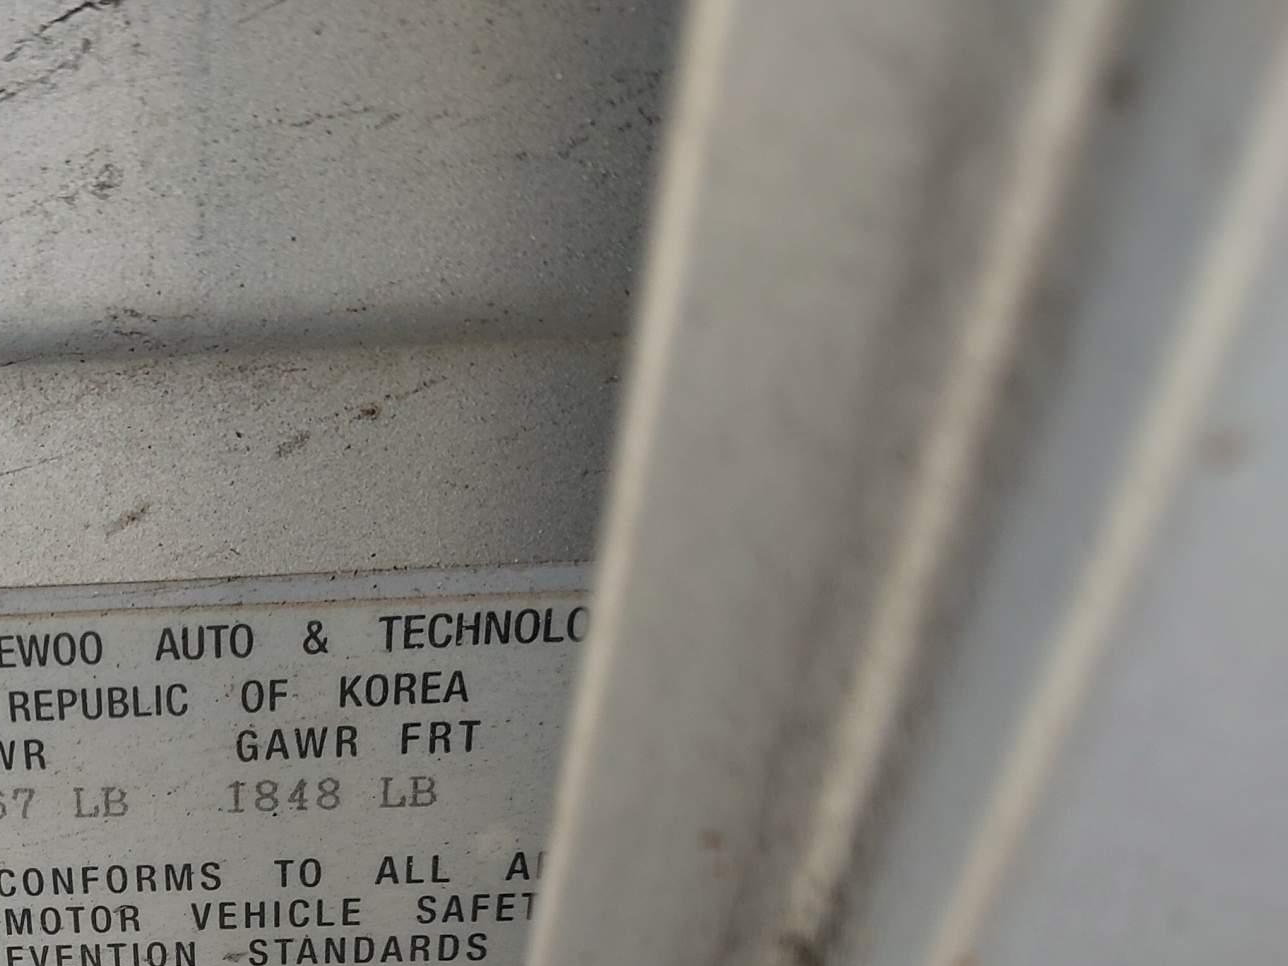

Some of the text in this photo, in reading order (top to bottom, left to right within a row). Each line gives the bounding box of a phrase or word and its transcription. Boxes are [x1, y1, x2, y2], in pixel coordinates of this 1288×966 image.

[155, 622, 254, 662] AUTO
[302, 620, 329, 654] &
[8, 671, 470, 723] REPUBLIC OF KOREA
[236, 725, 359, 762] GAWR
[401, 720, 481, 755] FRT
[73, 786, 129, 818] LB
[226, 776, 342, 814] 1848
[379, 775, 438, 809] LB
[274, 858, 322, 888] TO
[375, 855, 451, 885] ALL
[4, 905, 141, 936] MOTOR
[191, 897, 362, 931] VEHICLE
[248, 932, 488, 966] STANDARDS
